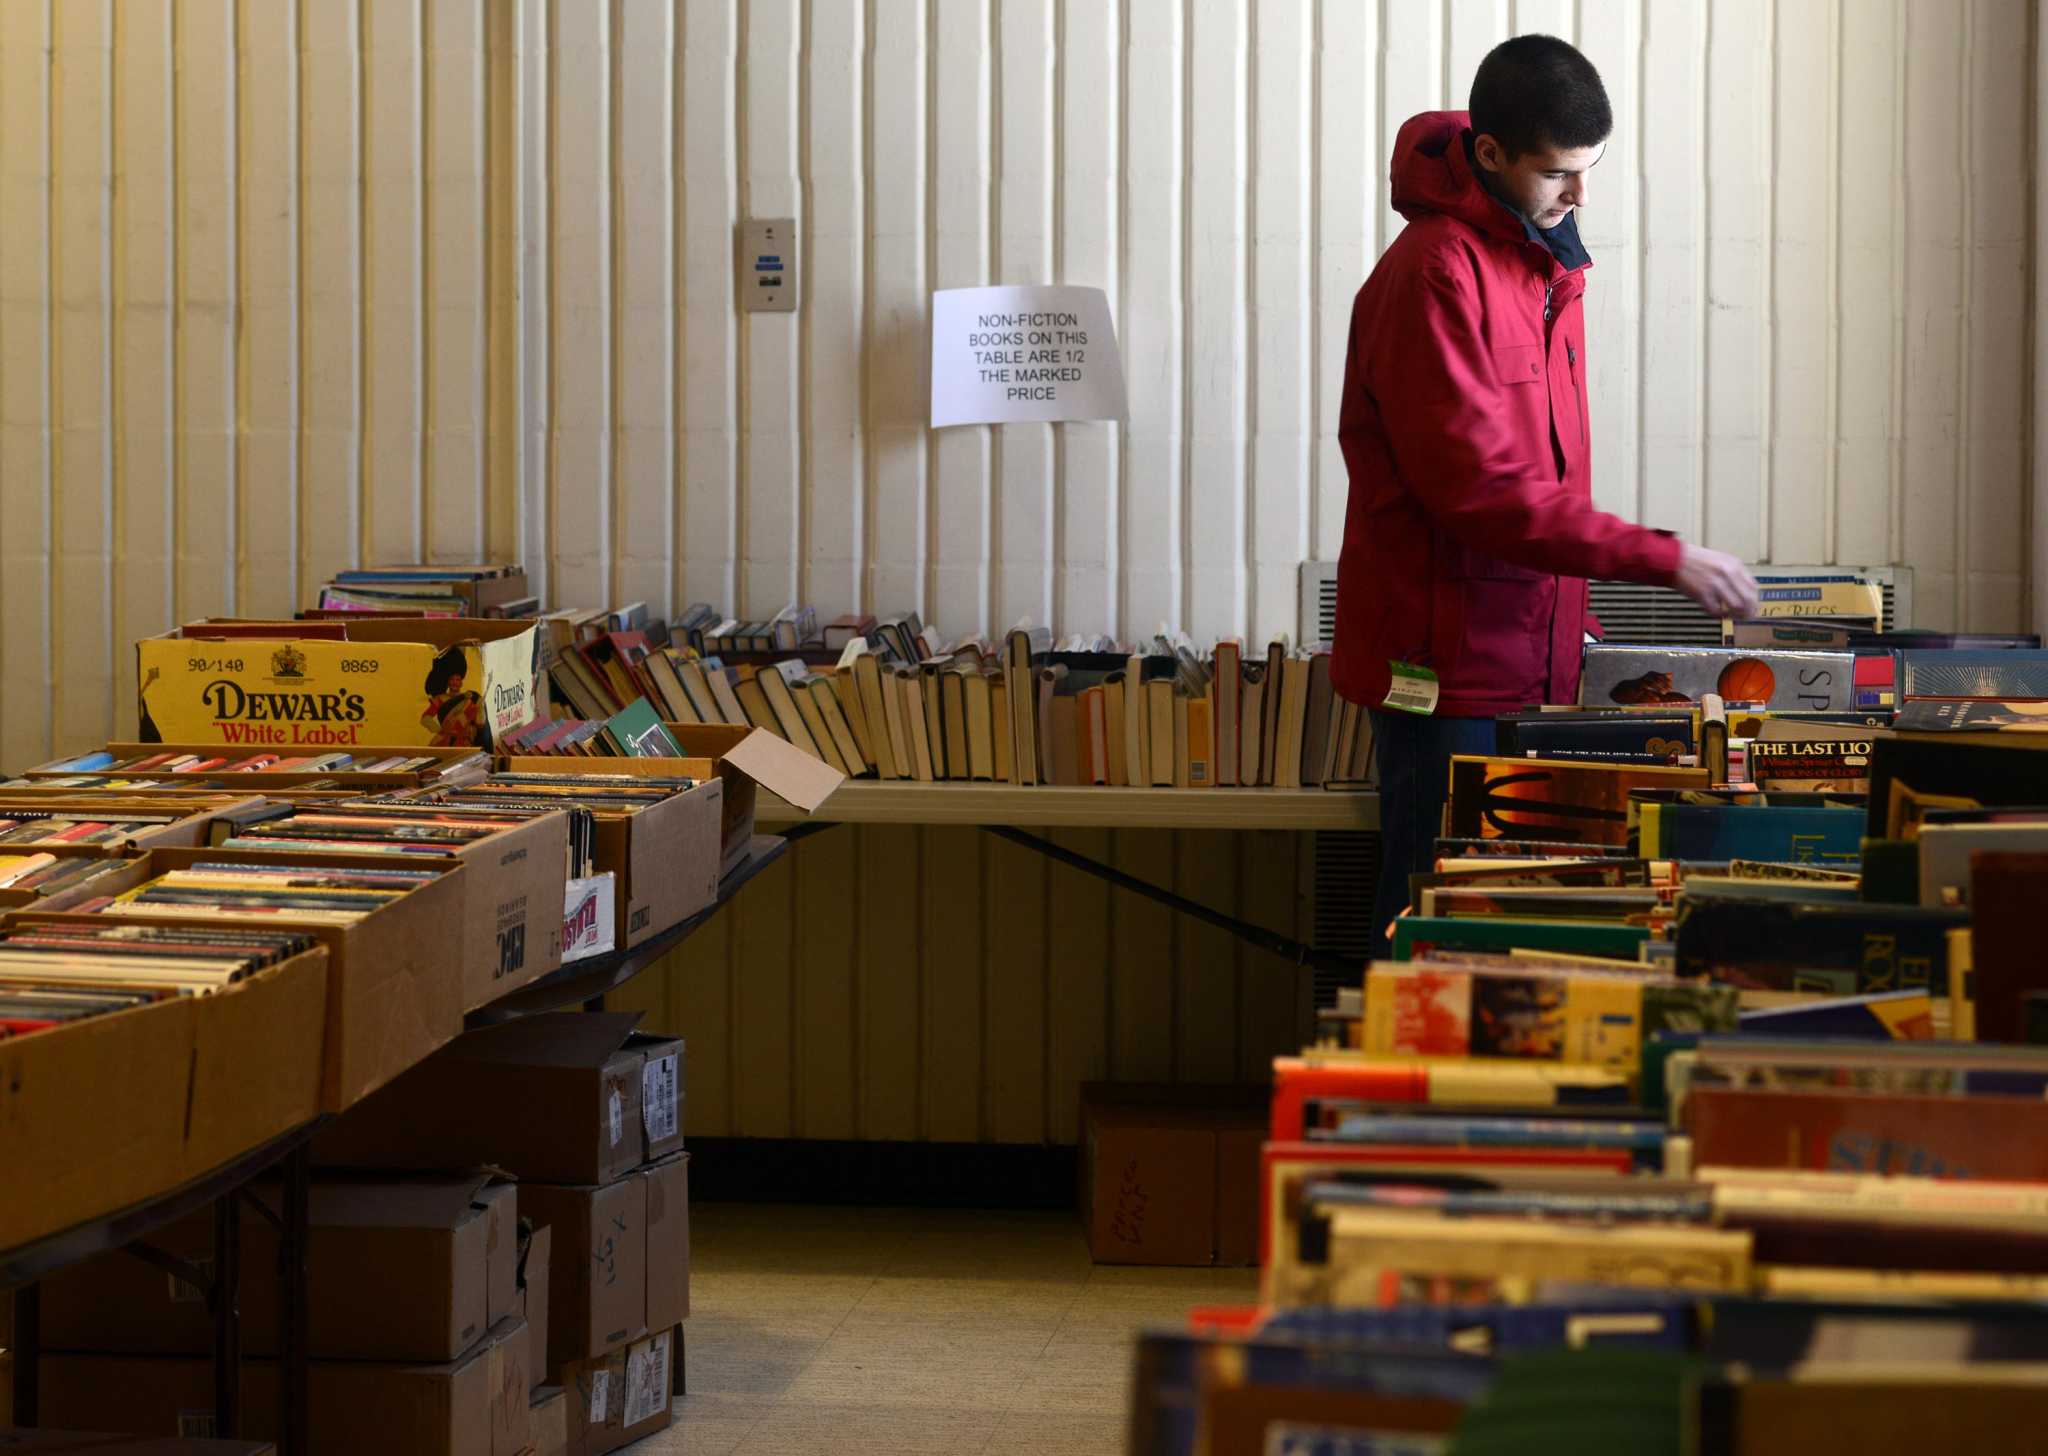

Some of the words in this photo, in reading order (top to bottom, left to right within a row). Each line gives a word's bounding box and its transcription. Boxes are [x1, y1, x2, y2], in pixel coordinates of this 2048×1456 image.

[978, 312, 1078, 328] NON-FICTION
[969, 332, 1024, 347] BOOKS
[1028, 332, 1052, 346] ON
[1056, 331, 1088, 345] THIS
[975, 351, 1024, 364] TABLE
[1028, 350, 1060, 364] ARE
[1067, 350, 1085, 363] 1/2
[979, 370, 1010, 382] THE
[1015, 368, 1082, 382] MARKED
[1007, 387, 1056, 400] PRICE
[188, 658, 244, 673] 90/140
[341, 659, 379, 673] 0869
[203, 679, 366, 722] DEWAR'S
[212, 722, 287, 745] "White
[291, 723, 364, 745] Label"
[1750, 743, 1788, 755] THE
[1791, 743, 1835, 755] LAST
[1839, 742, 1873, 755] LIO
